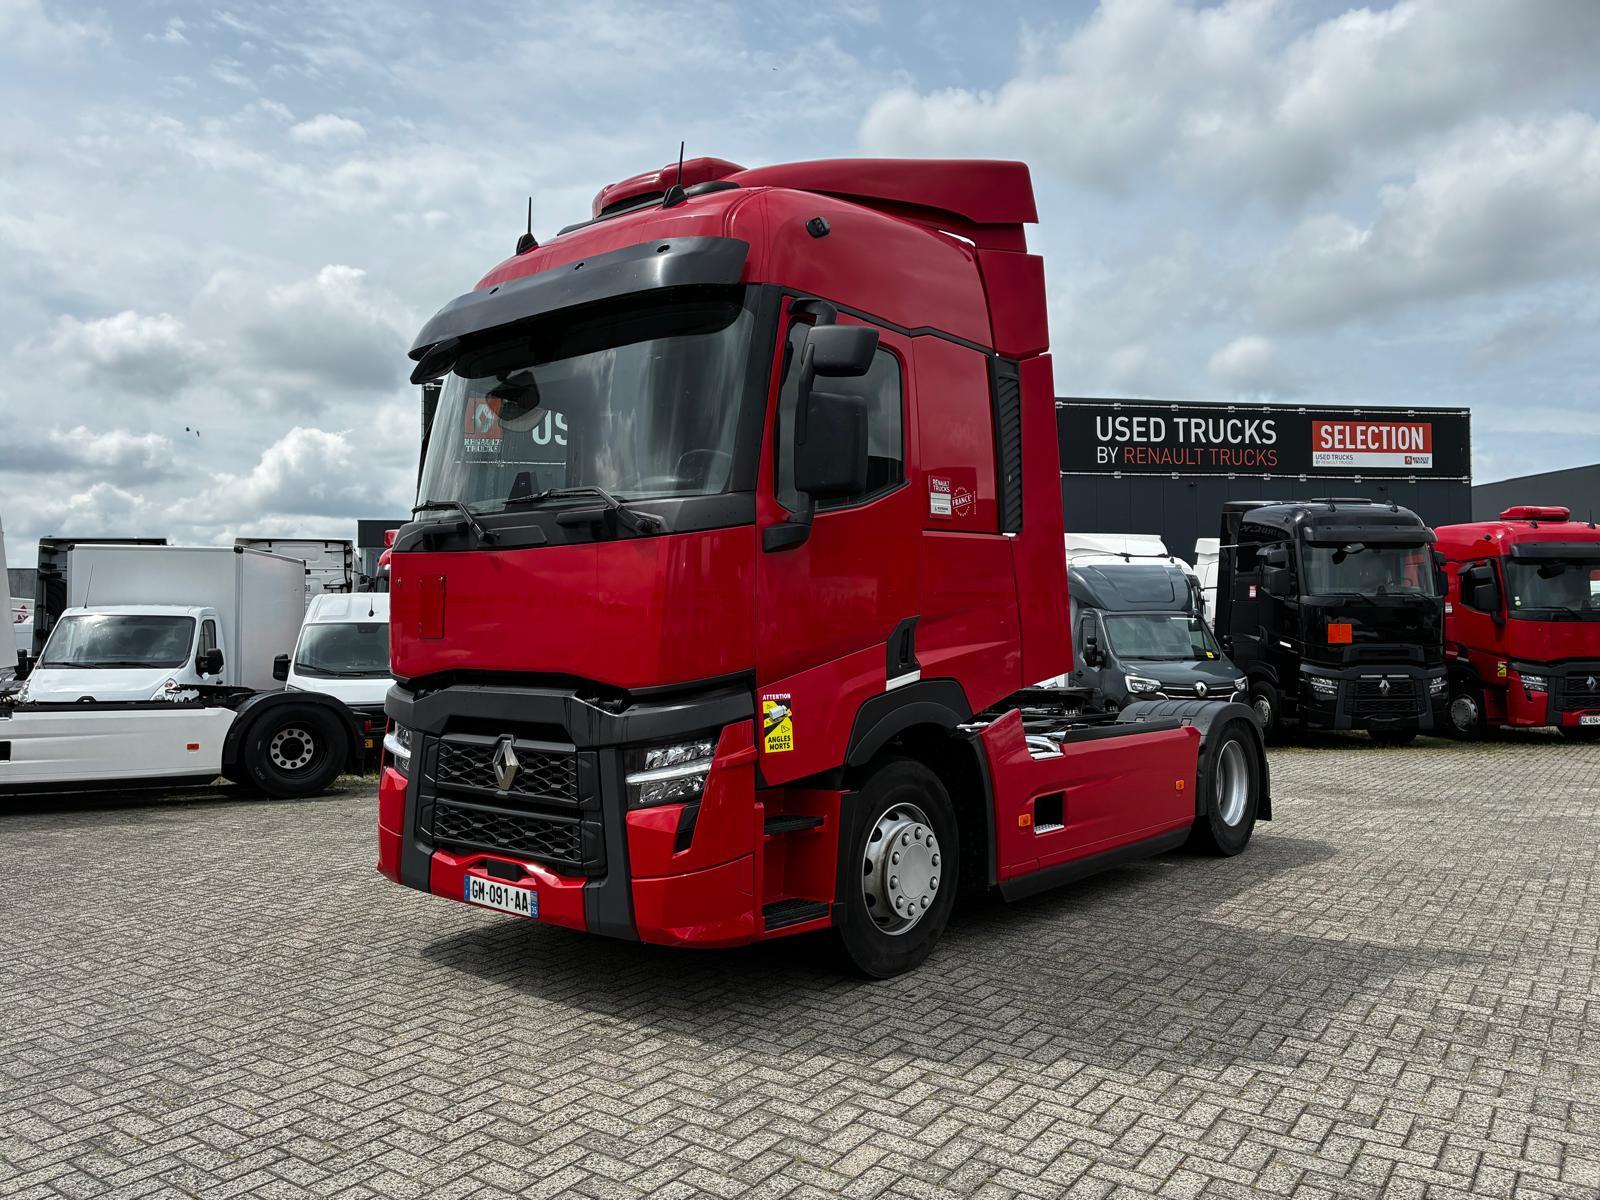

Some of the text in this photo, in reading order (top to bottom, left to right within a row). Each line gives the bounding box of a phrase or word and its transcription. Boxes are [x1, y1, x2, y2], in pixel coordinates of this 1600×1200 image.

[1096, 416, 1277, 444] USED TRUCKS
[1320, 425, 1423, 450] SELECTION
[1097, 446, 1278, 466] BY RENAULT TRUCKS
[952, 494, 972, 507] FRANCE
[472, 880, 528, 912] GM-091-AA
